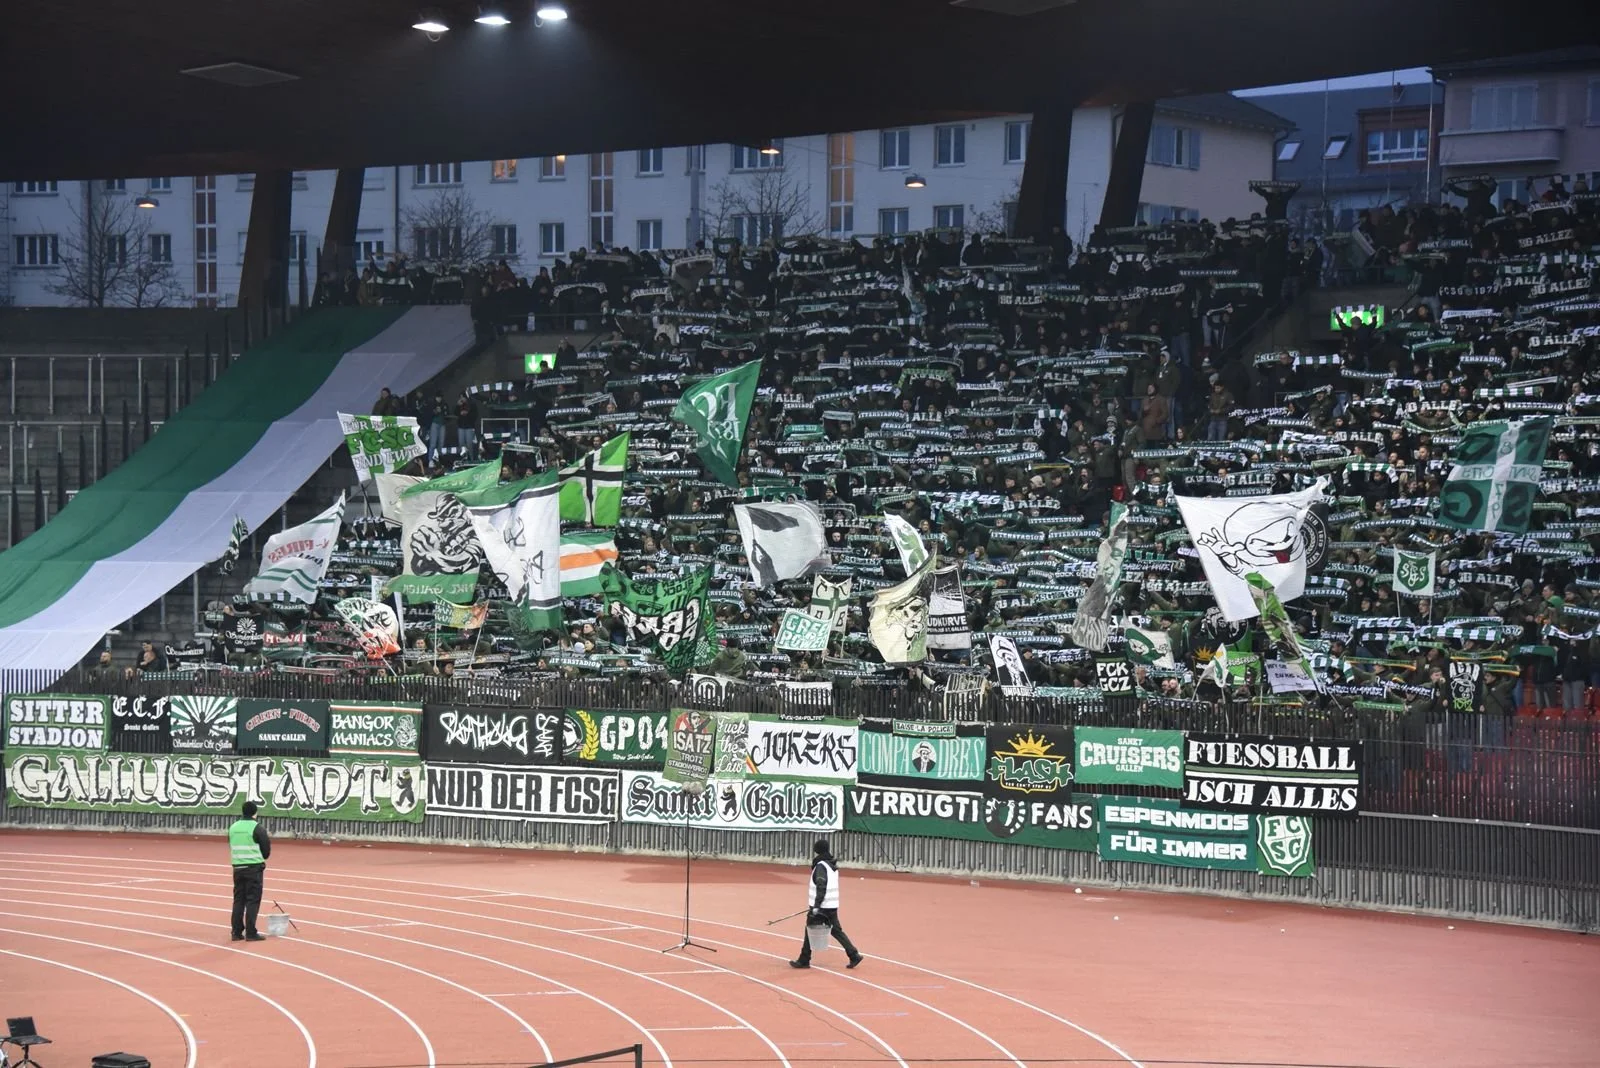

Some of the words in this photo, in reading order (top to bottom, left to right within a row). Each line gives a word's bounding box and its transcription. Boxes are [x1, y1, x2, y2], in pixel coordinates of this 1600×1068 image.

[1356, 617, 1402, 628] FCSG
[1096, 661, 1129, 678] FCK
[1449, 662, 1480, 682] ACAB
[1099, 675, 1132, 693] GCZ
[10, 700, 104, 724] SITTER
[332, 714, 394, 732] BANGOR
[8, 727, 103, 748] STADION
[258, 733, 281, 742] SANKT
[281, 733, 306, 742] GALLEN
[332, 732, 394, 747] MANIACS
[600, 715, 668, 752] GP04
[1117, 737, 1143, 746] SANKT
[752, 728, 857, 772] JOKERS
[1079, 741, 1181, 773] CRUISERS
[1187, 739, 1356, 771] FUESSBALL
[1115, 763, 1144, 773] GALLEN
[11, 753, 389, 814] GALLUSSTADT
[427, 768, 484, 809] NUR
[491, 771, 542, 812] DER
[549, 775, 617, 816] FCSG
[630, 780, 715, 818] Sankt
[745, 787, 835, 822] Gallen
[1187, 779, 1255, 806] ISCH
[1262, 785, 1358, 812] ALLES
[850, 790, 978, 824] VERRUGTI
[1031, 802, 1093, 830] FANS
[1105, 805, 1249, 831] ESPENMOOS
[1111, 831, 1157, 854] FÜR
